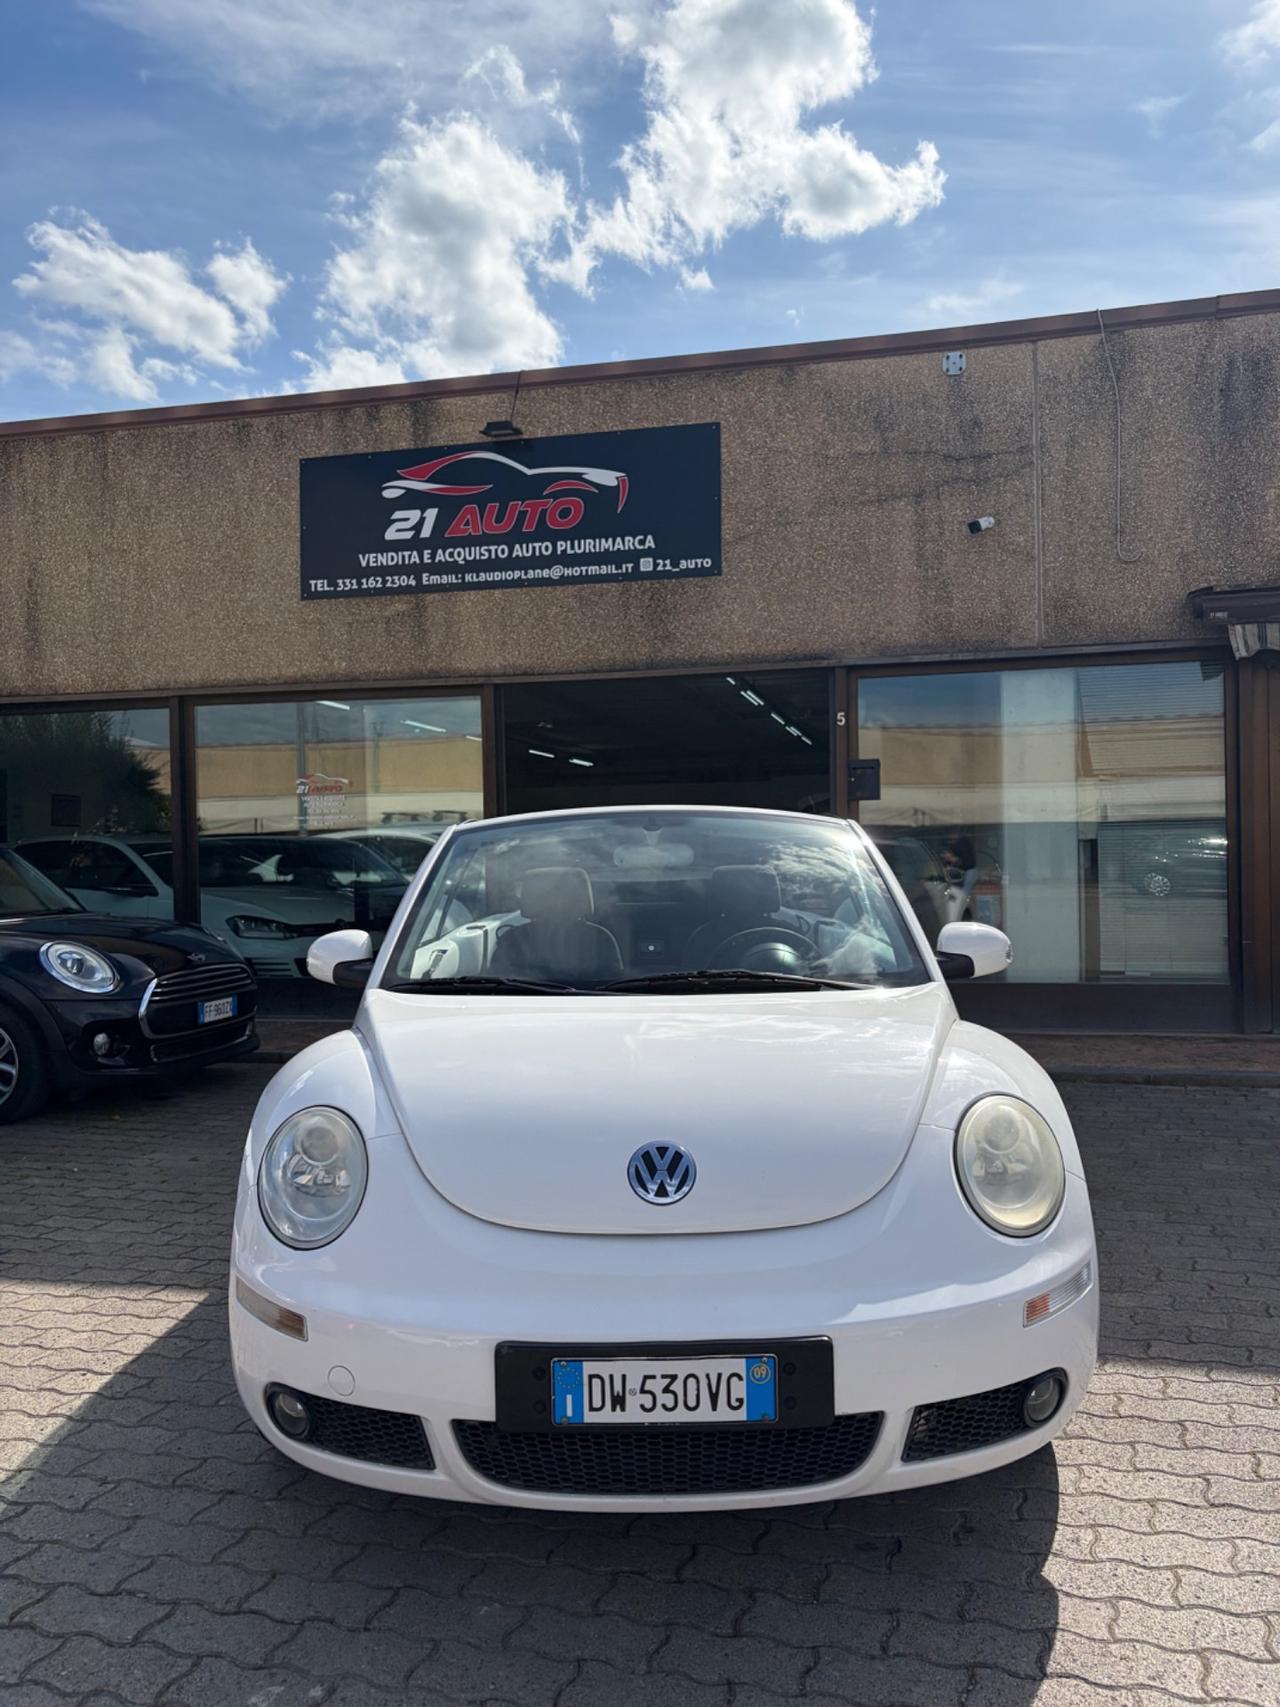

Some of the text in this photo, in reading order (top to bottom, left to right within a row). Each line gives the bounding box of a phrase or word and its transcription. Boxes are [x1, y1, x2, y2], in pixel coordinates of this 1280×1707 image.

[384, 497, 584, 540] 21 AUTO
[358, 534, 656, 567] VENDITA E ACQUISTO AUTO PLURIMARCA
[309, 579, 334, 592] TEL.
[336, 578, 358, 591] 331
[361, 576, 383, 589] 162
[385, 575, 417, 588] 2304
[836, 711, 846, 726] 5
